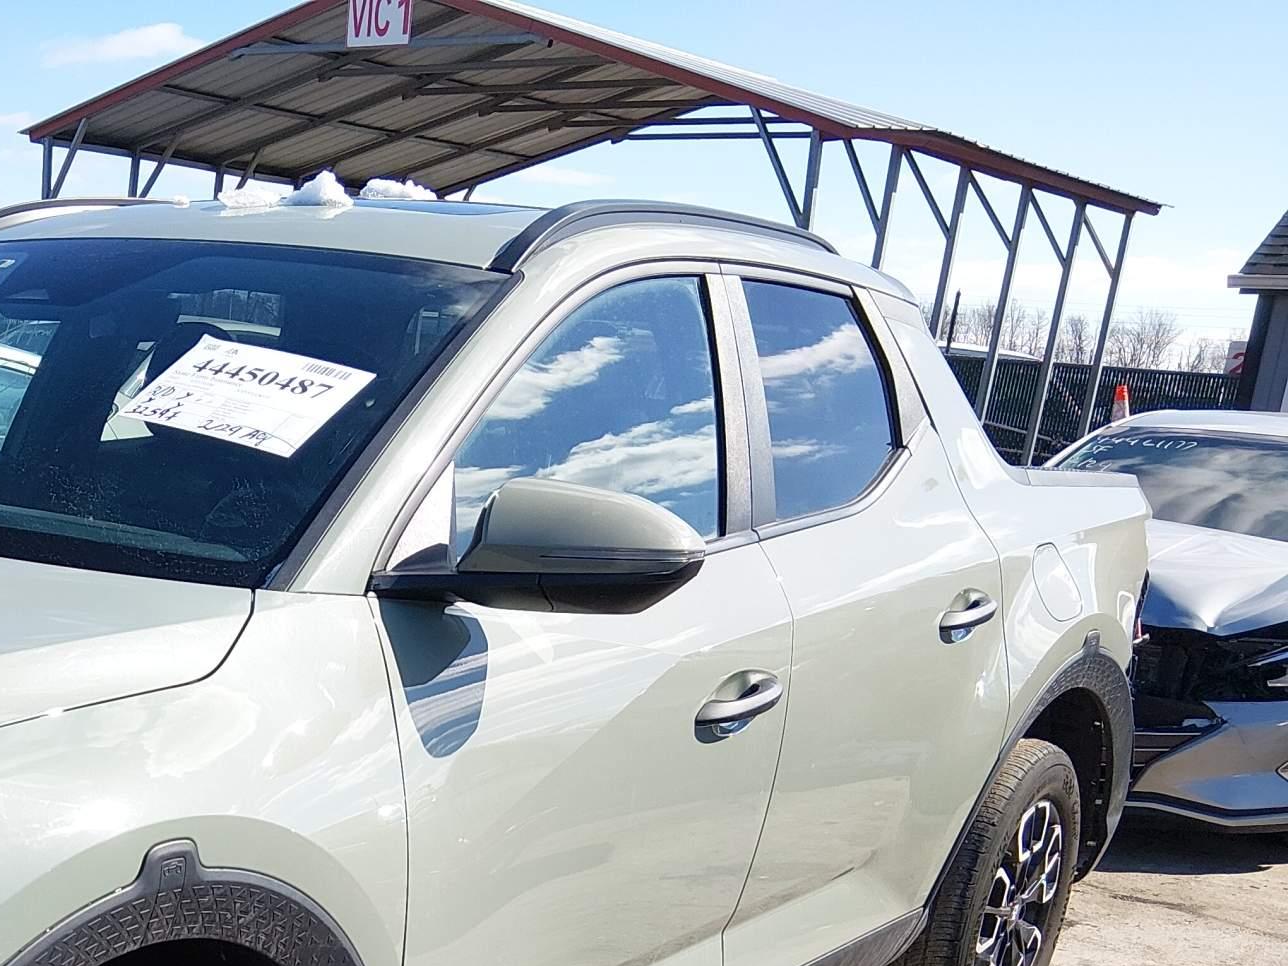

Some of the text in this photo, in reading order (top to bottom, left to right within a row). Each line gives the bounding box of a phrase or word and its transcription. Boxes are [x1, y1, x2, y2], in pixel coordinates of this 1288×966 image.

[352, 0, 411, 38] VIC 1
[192, 359, 335, 399] 44450487
